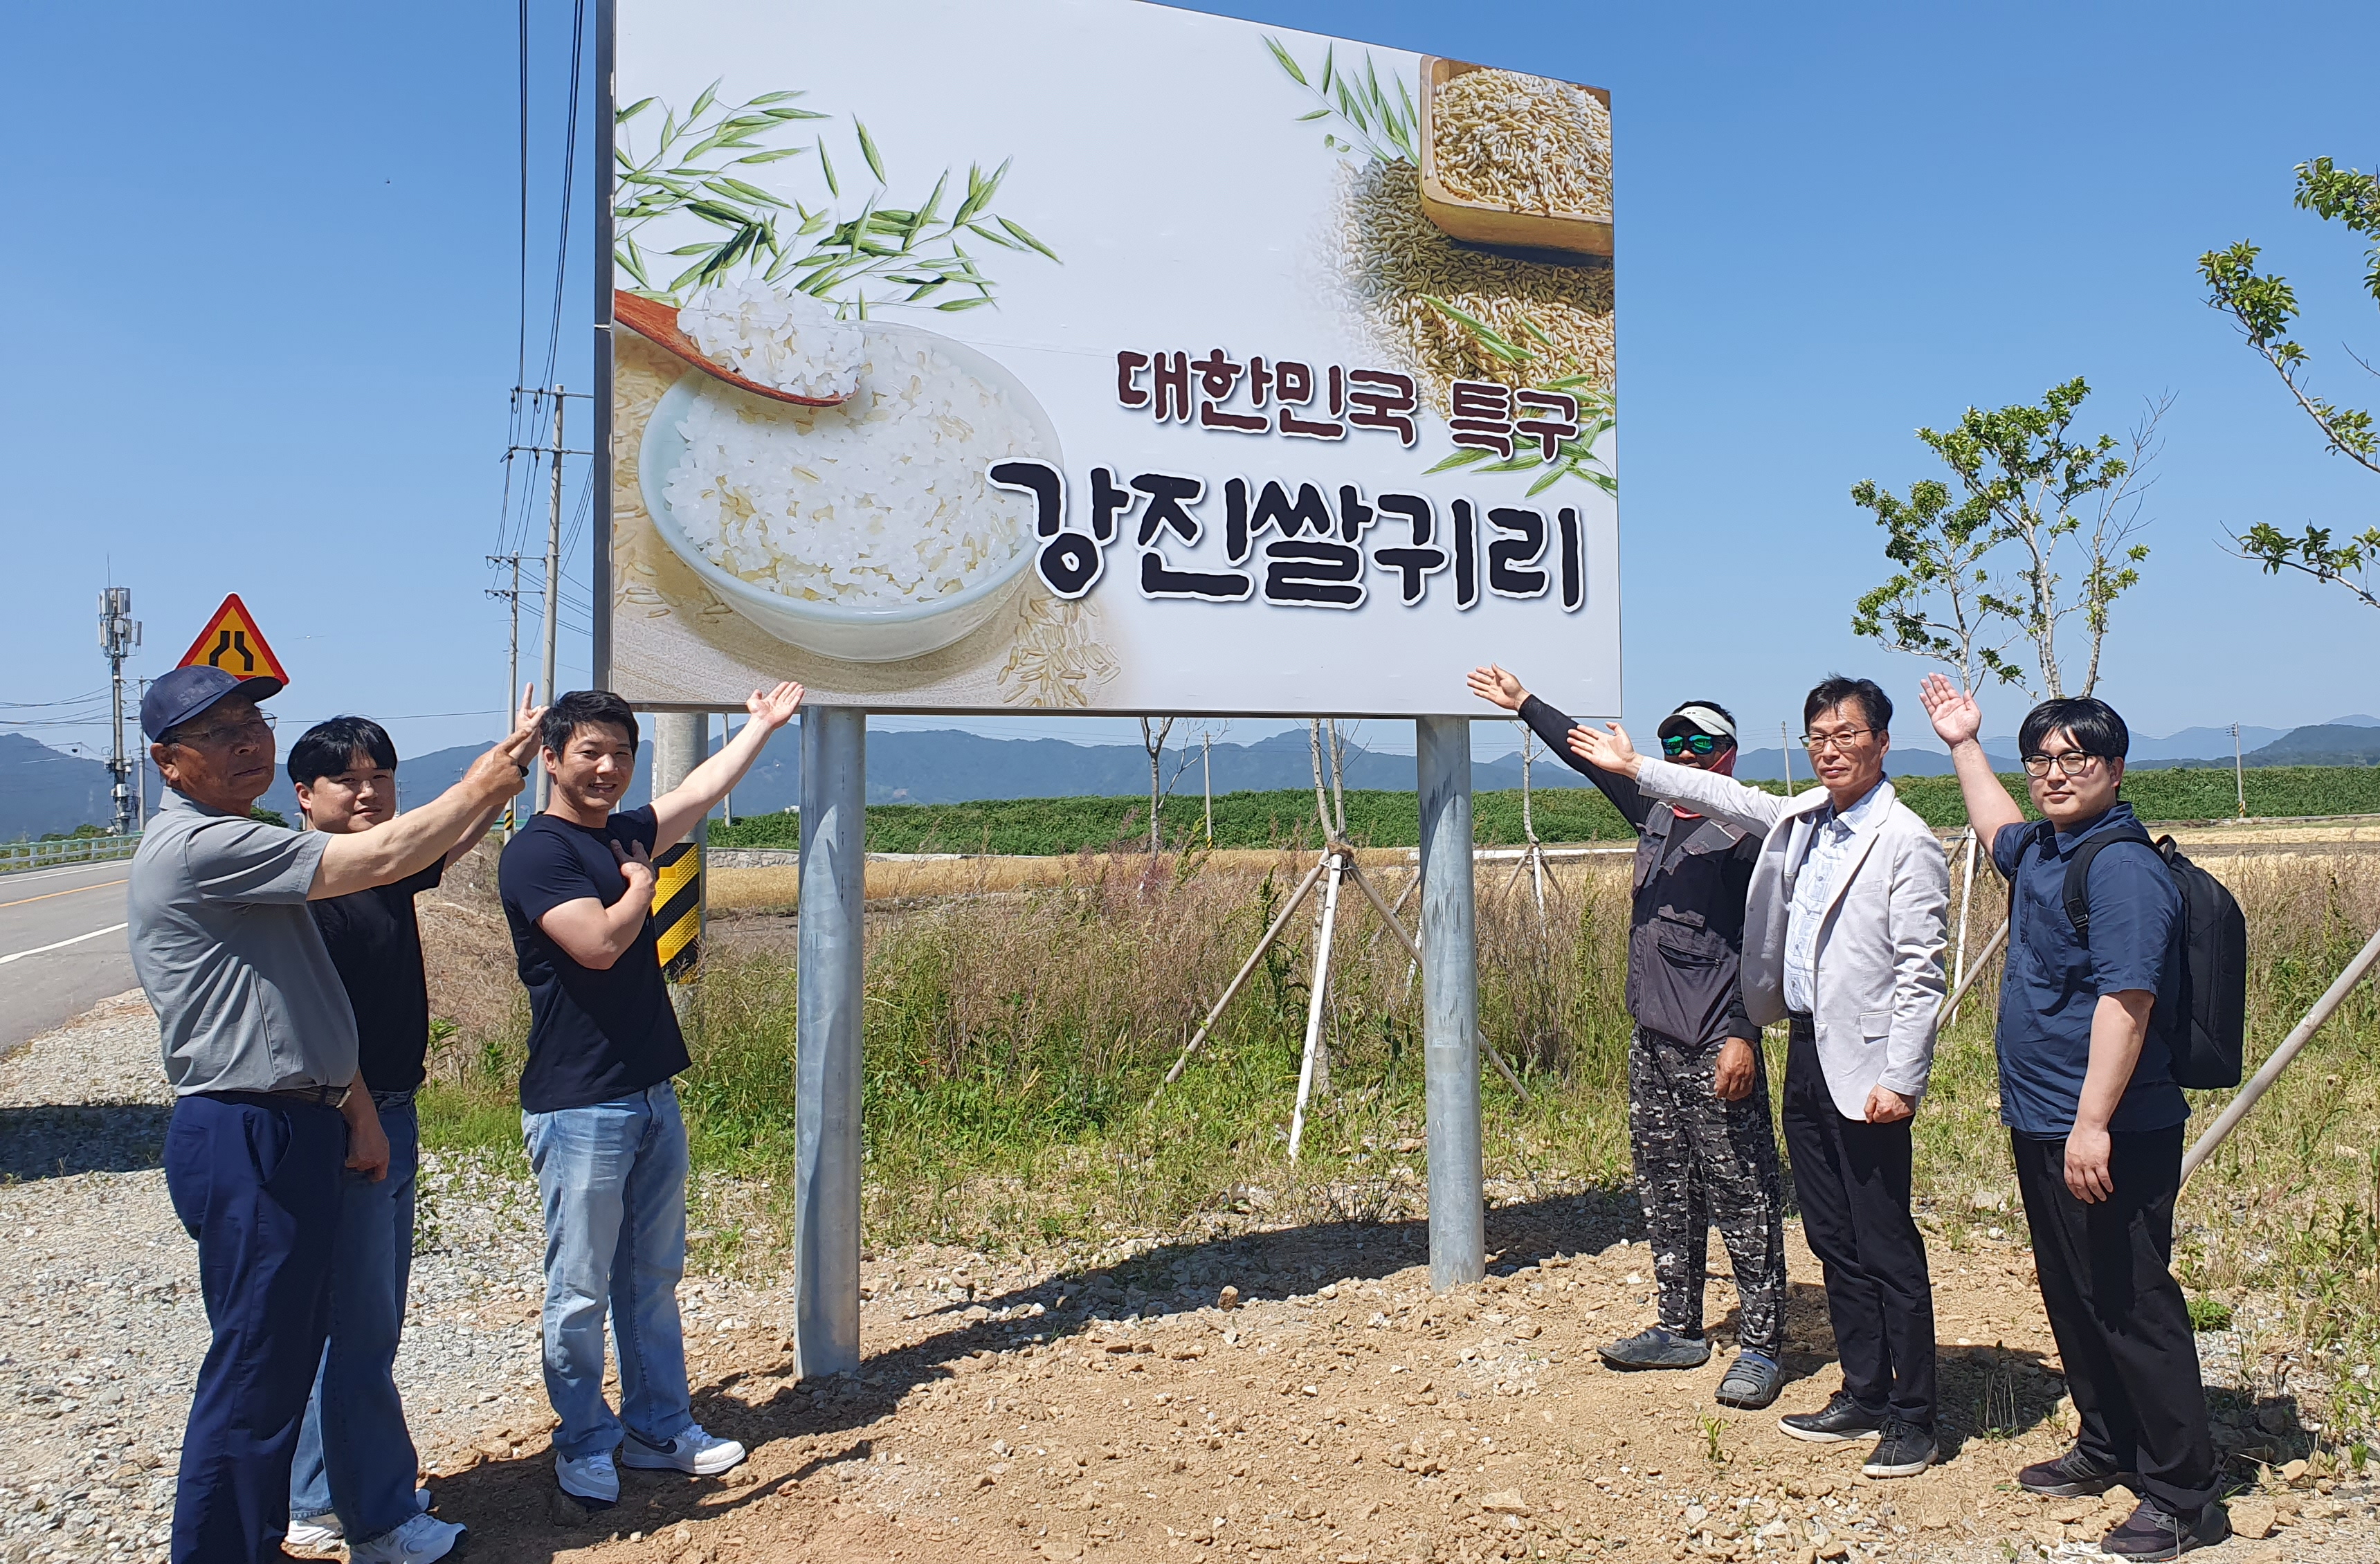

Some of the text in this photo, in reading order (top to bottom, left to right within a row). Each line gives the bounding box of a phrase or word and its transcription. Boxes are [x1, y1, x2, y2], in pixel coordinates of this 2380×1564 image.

[1115, 346, 1579, 462] 대한민국 특구
[988, 460, 1582, 610] 강진쌀귀리
